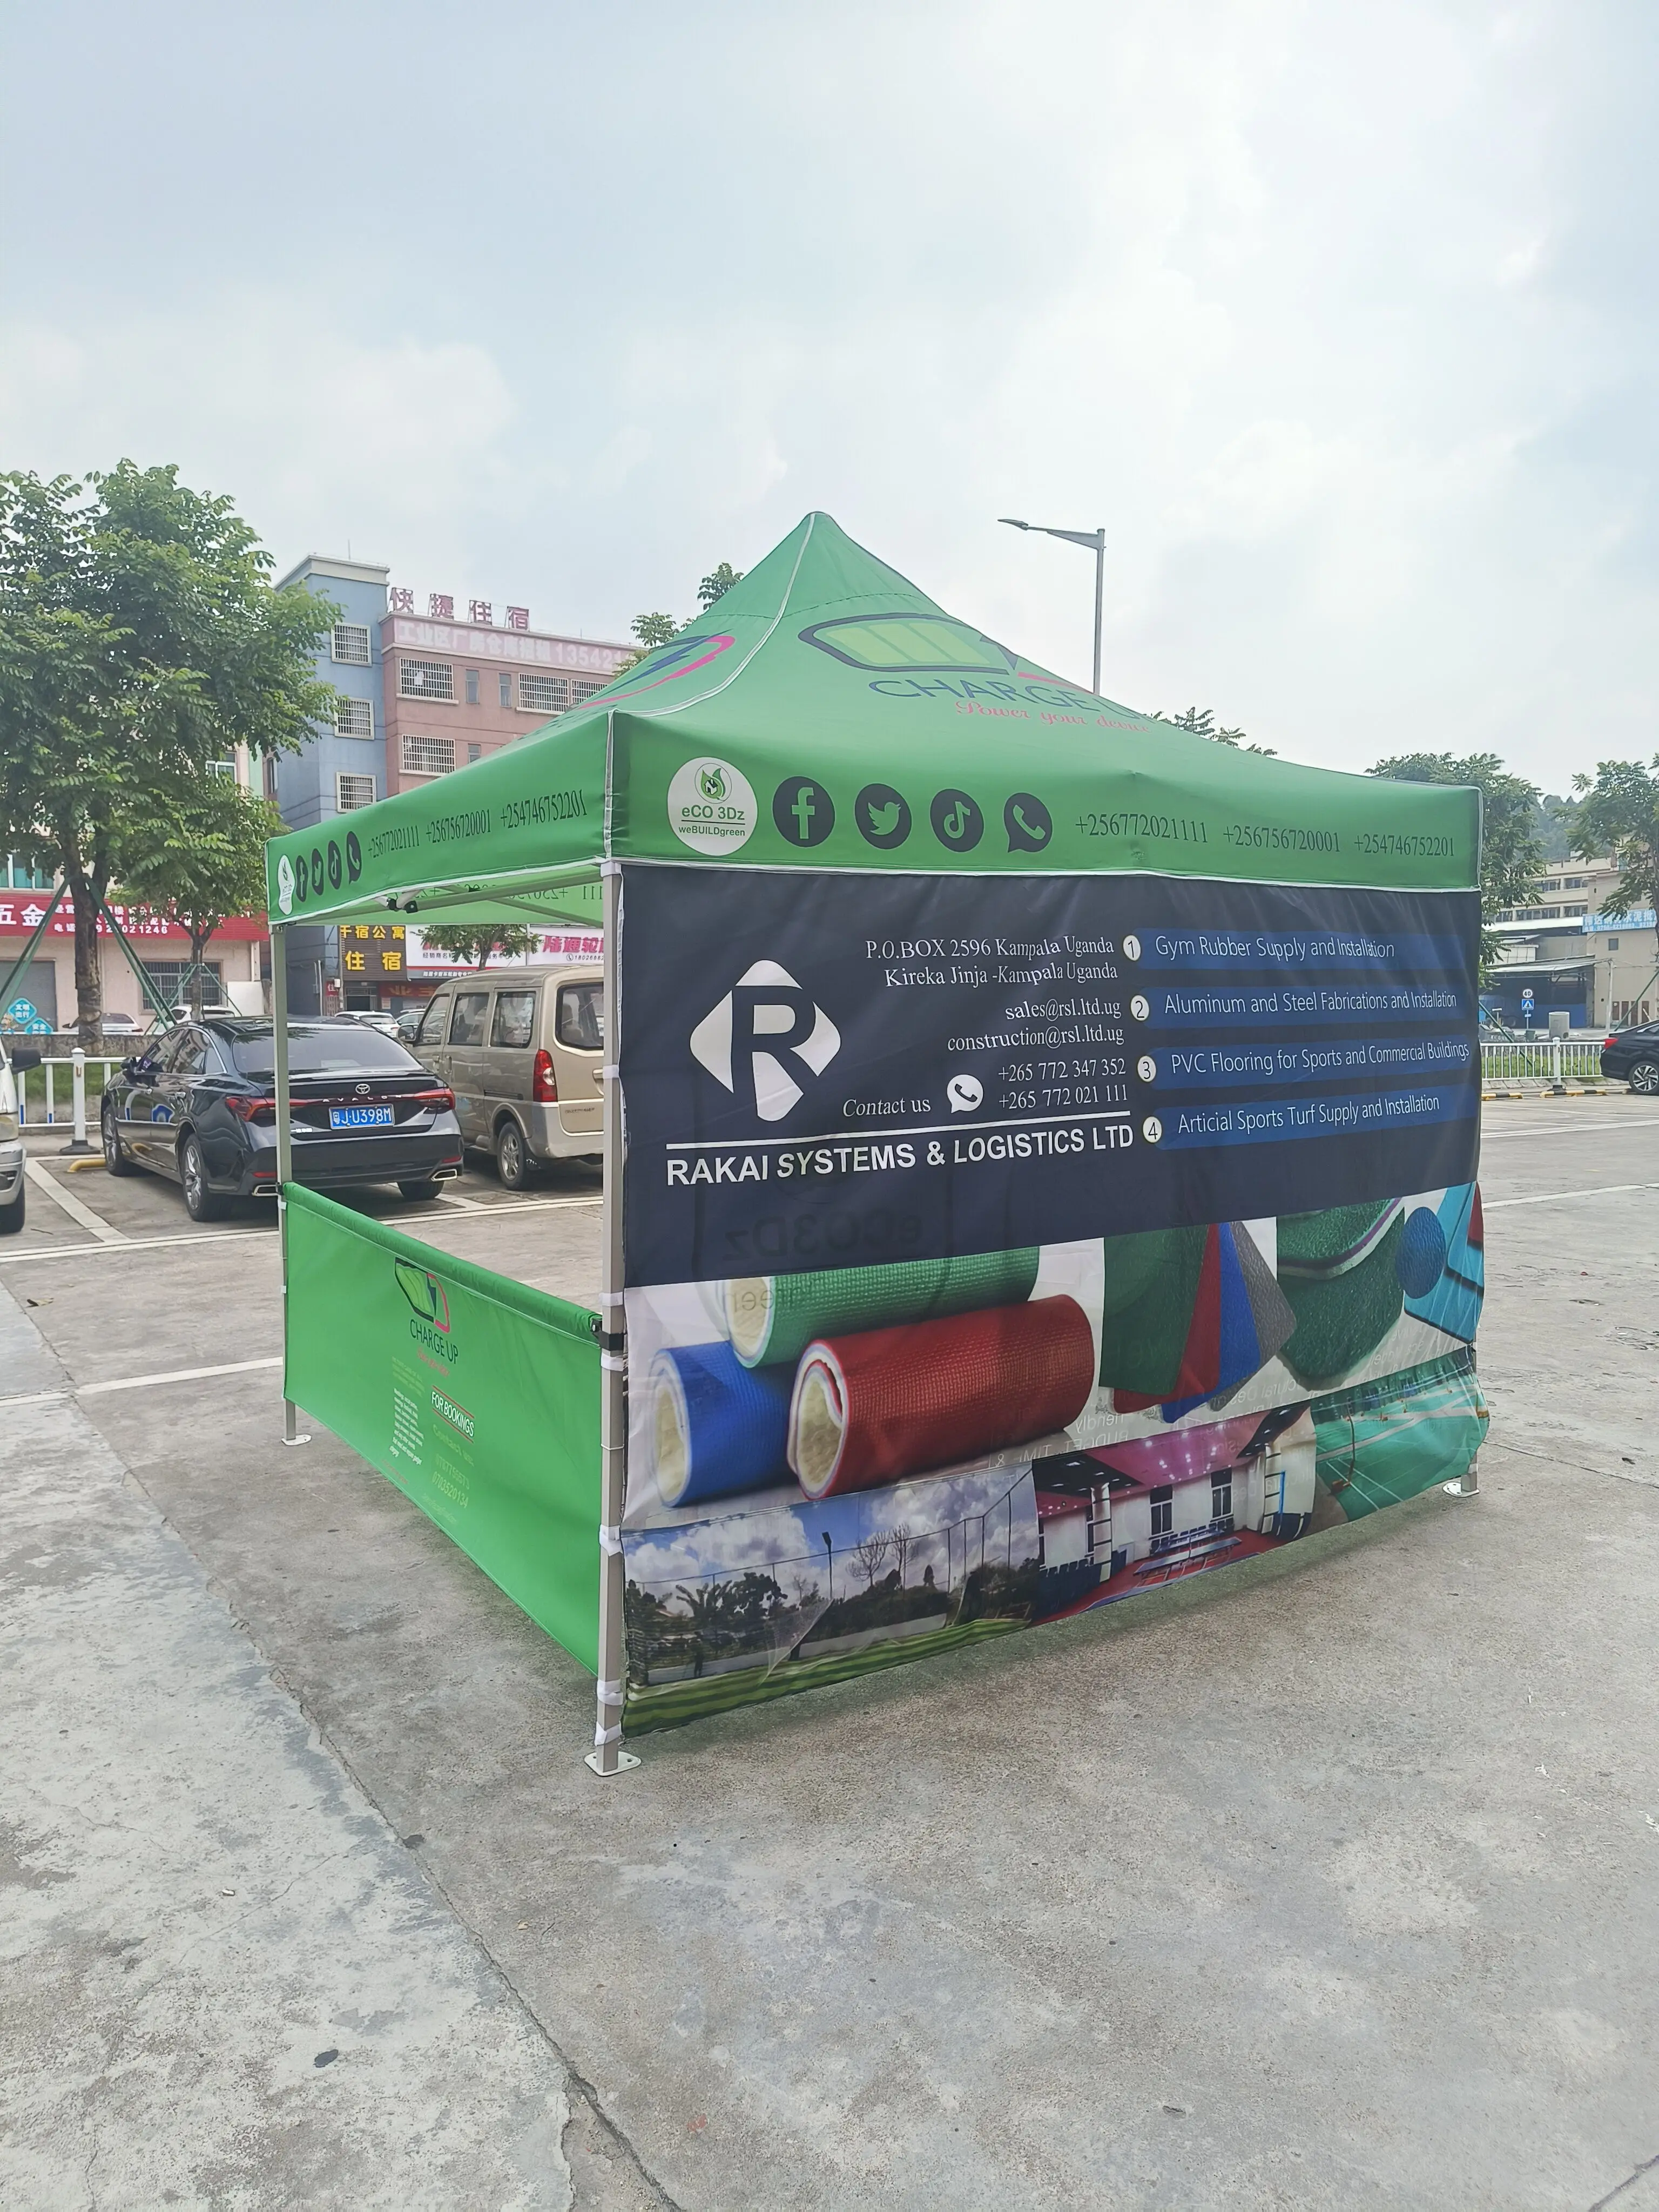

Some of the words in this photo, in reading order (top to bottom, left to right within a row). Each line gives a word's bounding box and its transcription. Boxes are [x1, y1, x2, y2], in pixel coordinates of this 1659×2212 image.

[868, 679, 1101, 713] CHARGE
[955, 701, 1030, 719] Power
[1040, 712, 1088, 725] your
[368, 825, 420, 858] +256772021111
[426, 809, 491, 844] +256756720001
[500, 789, 588, 829] +254746752201
[681, 805, 713, 820] eCO
[717, 806, 745, 821] 3Dz
[678, 824, 746, 838] weBUILDgreen
[1075, 813, 1209, 844] +256772021111
[1223, 825, 1340, 853] +256756720001
[1354, 833, 1455, 857] +254746752201
[345, 950, 402, 971] 住宿
[866, 939, 946, 960] P.O.BOX
[950, 938, 992, 957] 2596
[995, 939, 1061, 960] Kampala
[1063, 935, 1115, 957] Uganda
[1155, 935, 1195, 958] Gym
[1200, 936, 1250, 957] Rubber
[1257, 938, 1306, 962] Supply
[1311, 939, 1336, 956] and
[1338, 939, 1395, 958] Installation
[884, 968, 946, 988] Kireka
[950, 966, 987, 988] Jinja
[992, 963, 1063, 986] -Kampala
[1067, 962, 1118, 983] Uganda
[1005, 998, 1122, 1021] sales@rsl.ltd.ug
[1165, 995, 1245, 1015] Aluminum
[1250, 994, 1278, 1013] and
[1284, 993, 1317, 1011] Steel
[1321, 990, 1388, 1010] Fabrications
[1391, 991, 1410, 1008] and
[1412, 990, 1456, 1008] Installation
[947, 1024, 1124, 1050] construction@rsl.ltd.ug
[998, 1063, 1033, 1082] +265
[1038, 1061, 1069, 1080] 772
[1073, 1060, 1098, 1078] 347
[1101, 1058, 1127, 1076] 352
[1171, 1053, 1205, 1074] PVC
[1211, 1051, 1273, 1076] Flooring
[1277, 1050, 1297, 1069] for
[1302, 1049, 1341, 1072] Sports
[1346, 1049, 1366, 1066] and
[1368, 1042, 1426, 1063] Commercial
[1427, 1040, 1469, 1061] Buildings
[842, 1098, 907, 1118] Contact
[913, 1097, 931, 1114] us
[998, 1090, 1037, 1110] +265
[1042, 1088, 1072, 1107] 772
[1075, 1085, 1101, 1104] 021
[1105, 1084, 1128, 1102] 111
[1178, 1110, 1232, 1134] Articial
[1237, 1110, 1284, 1135] Sports
[1287, 1104, 1316, 1127] Turf
[1319, 1104, 1359, 1124] Supply
[1362, 1101, 1381, 1118] and
[1385, 1095, 1439, 1115] Installation
[666, 1155, 768, 1186] RAKAI
[777, 1143, 915, 1179] SYSTEMS
[926, 1140, 945, 1166] &
[954, 1128, 1085, 1163] LOGISTICS
[1092, 1124, 1134, 1150] LTD
[410, 1319, 445, 1357] CHARGE
[446, 1339, 458, 1364] UP
[432, 1391, 444, 1412] FOR
[444, 1401, 474, 1437] BOOKINGS
[432, 1471, 469, 1508] 0703520134
